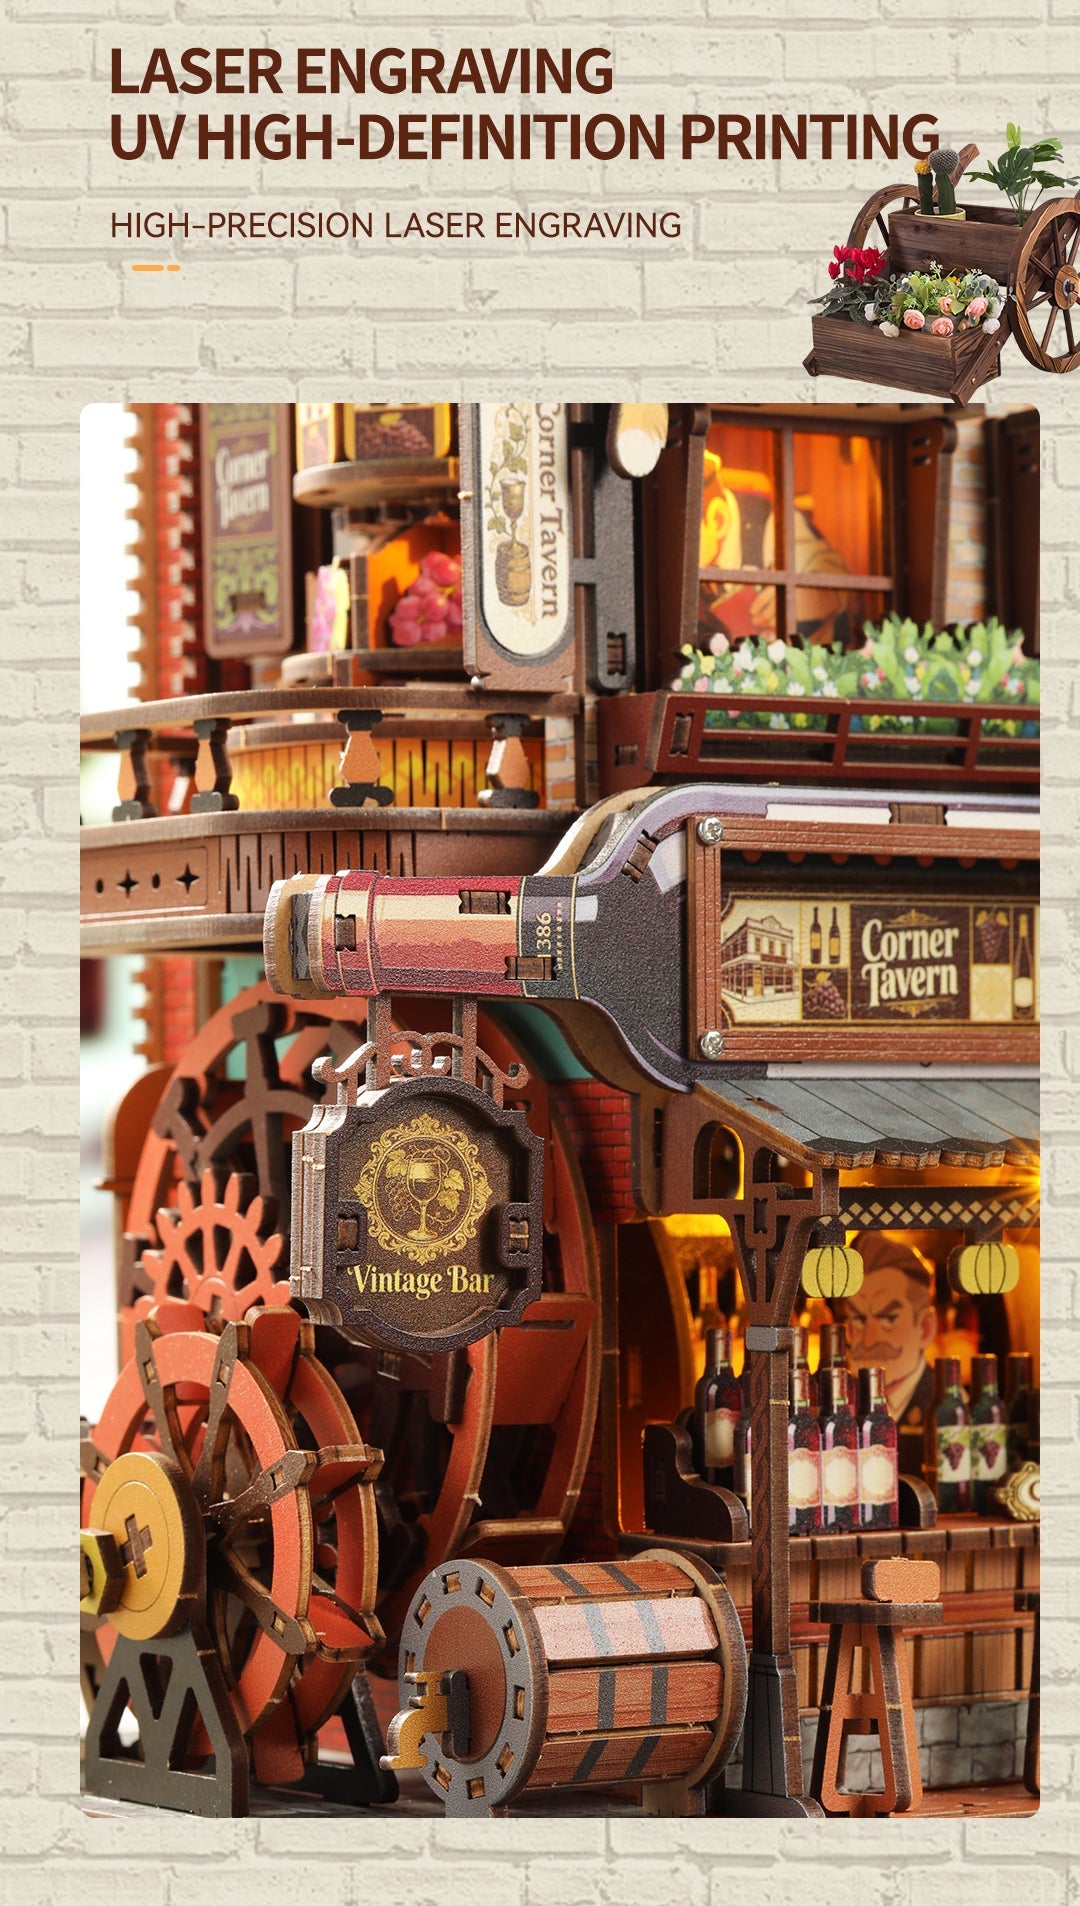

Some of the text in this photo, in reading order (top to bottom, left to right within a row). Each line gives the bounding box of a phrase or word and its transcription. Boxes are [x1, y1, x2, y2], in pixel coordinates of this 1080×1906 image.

[539, 507, 565, 618] Tavern
[861, 918, 960, 962] Corner
[861, 961, 959, 1008] Tavern
[346, 1263, 495, 1301] Vintage Bar
